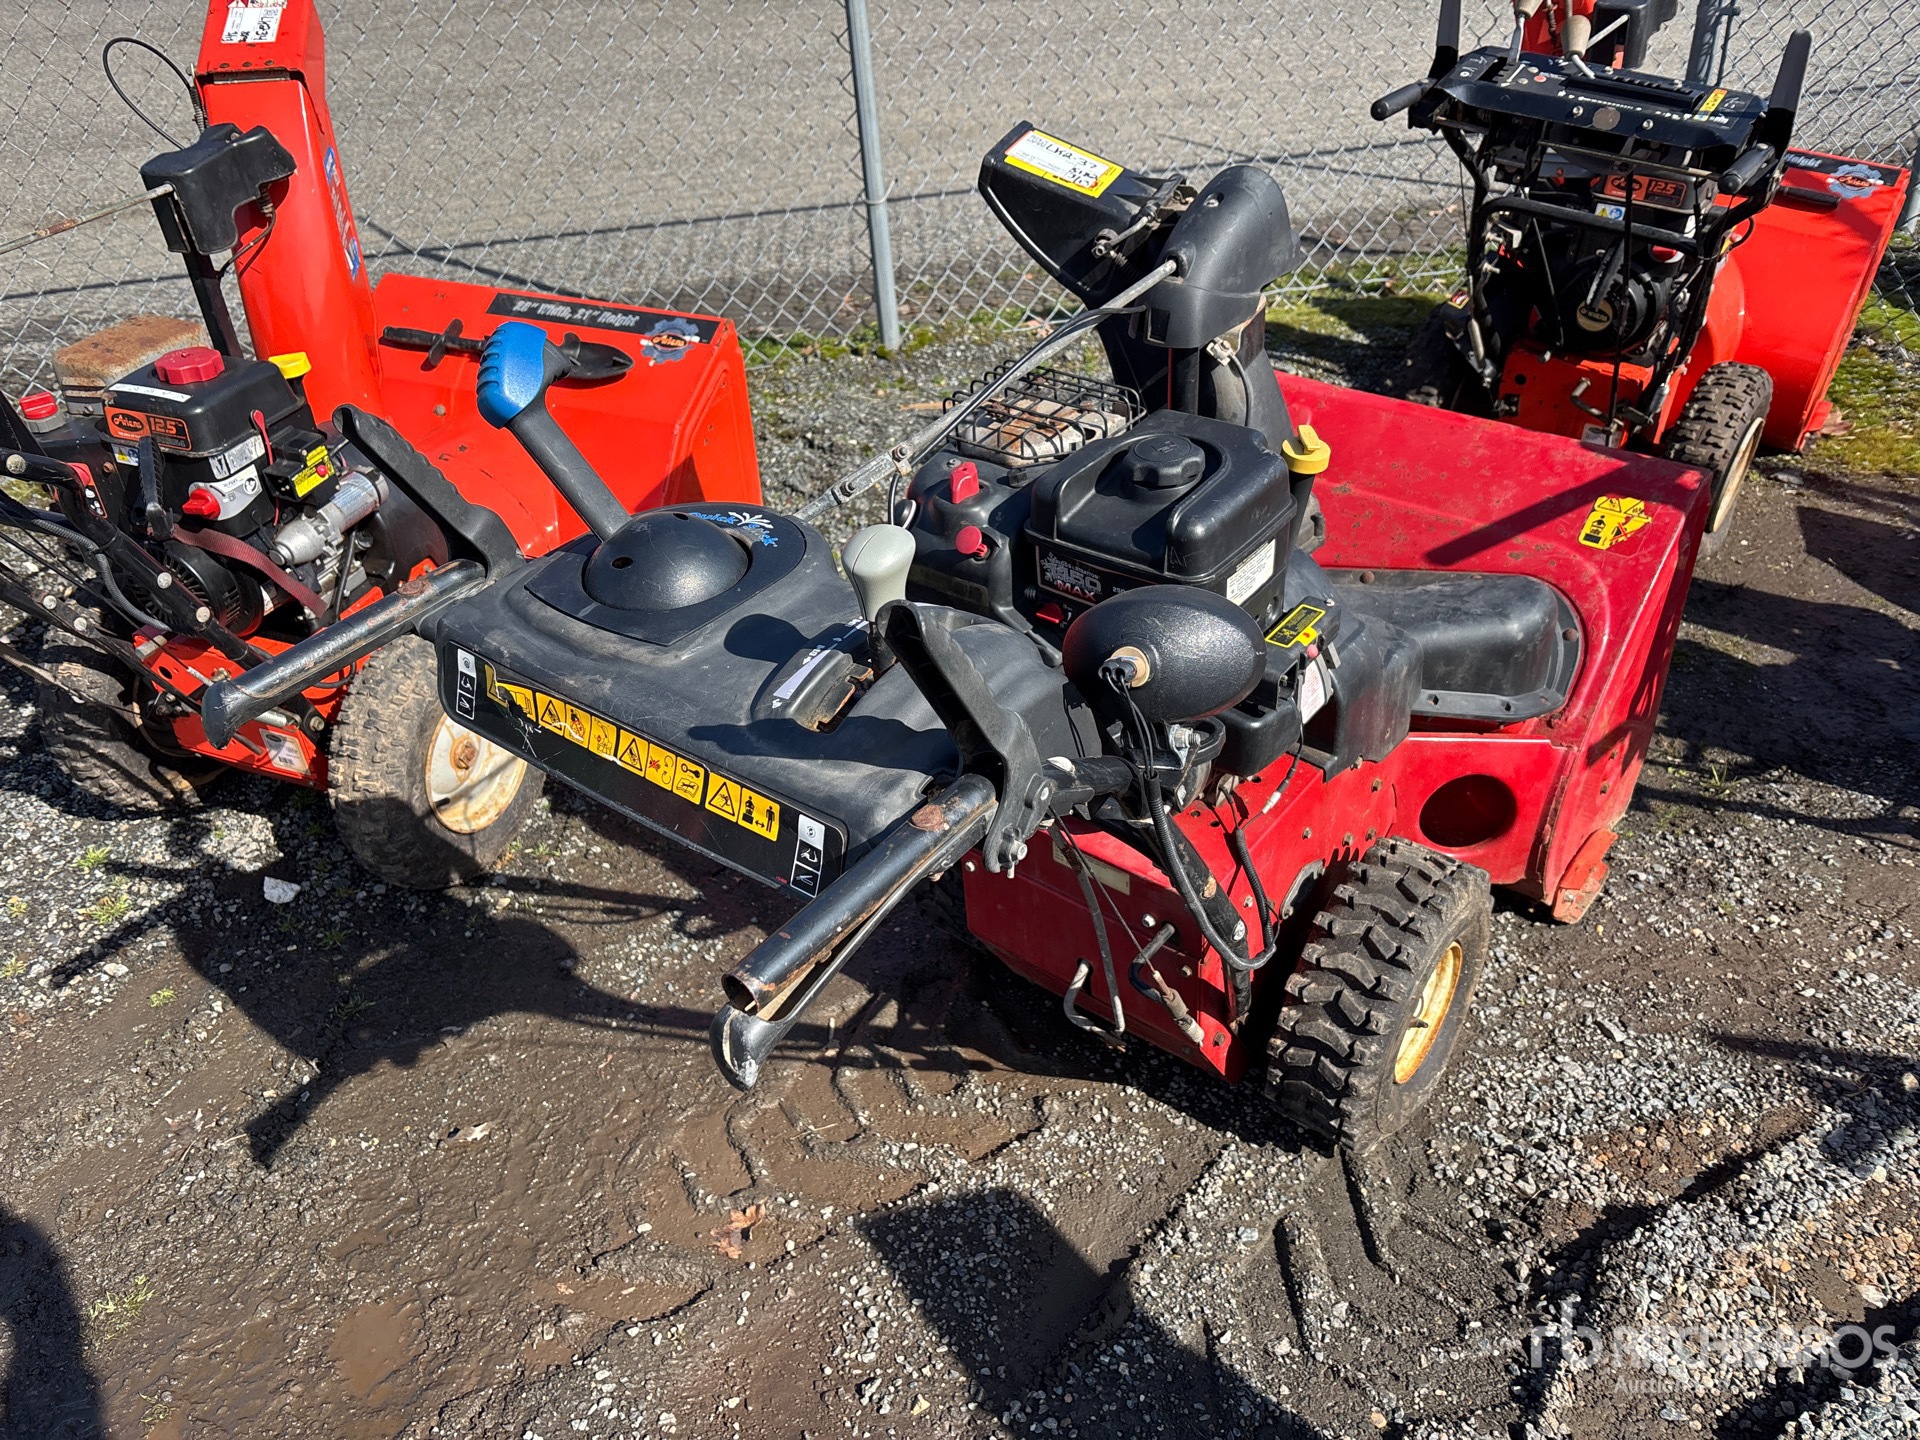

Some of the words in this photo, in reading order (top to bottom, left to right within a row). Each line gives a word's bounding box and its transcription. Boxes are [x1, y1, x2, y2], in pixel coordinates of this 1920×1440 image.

[1649, 180, 1676, 195] 12.5
[1839, 175, 1870, 187] Ariens
[598, 312, 640, 327] Height
[652, 333, 686, 348] Ariens
[113, 414, 142, 429] Ariens
[149, 417, 177, 435] 12.5
[1056, 580, 1096, 602] MAX
